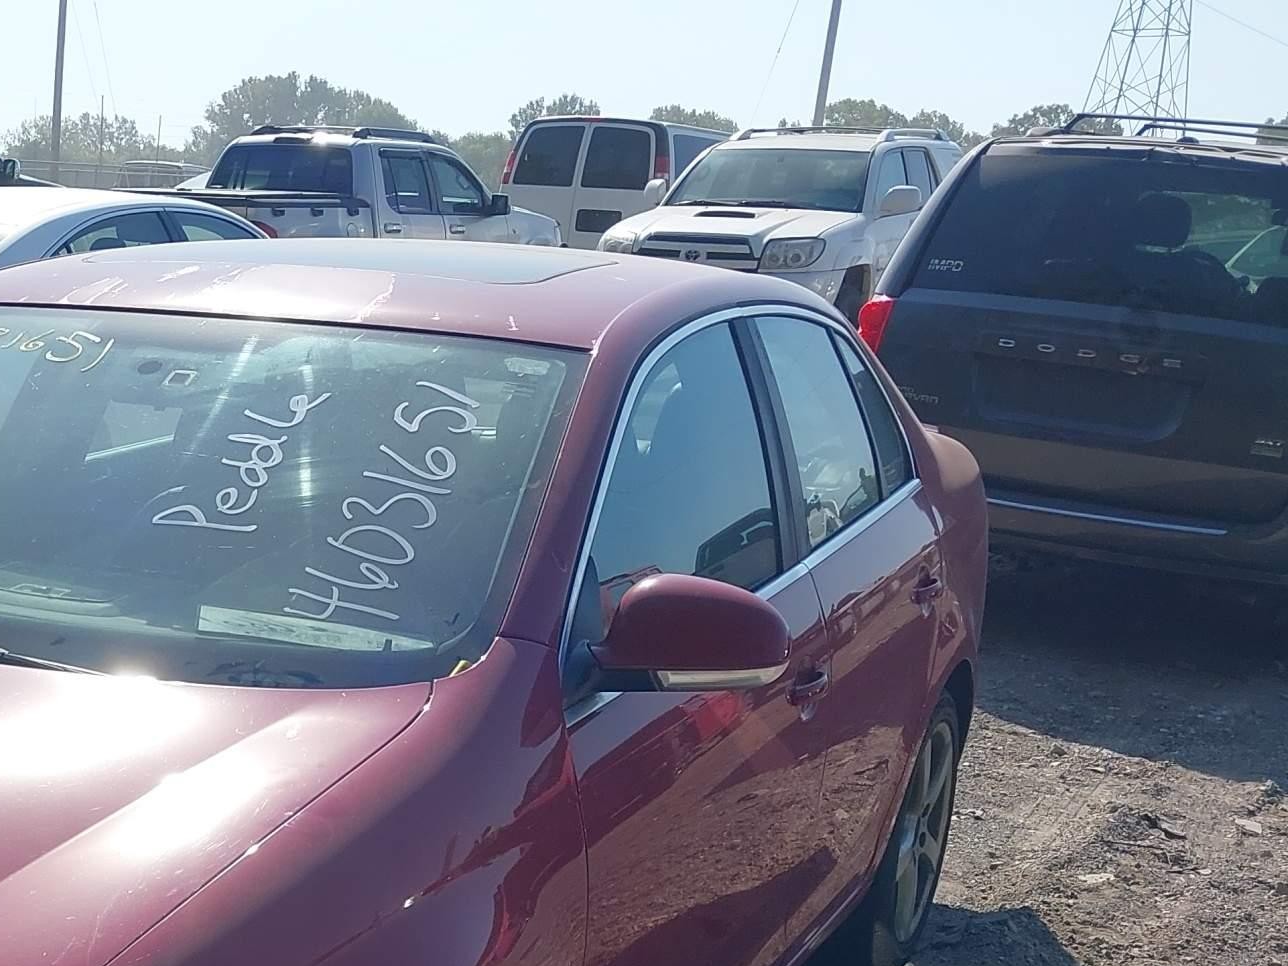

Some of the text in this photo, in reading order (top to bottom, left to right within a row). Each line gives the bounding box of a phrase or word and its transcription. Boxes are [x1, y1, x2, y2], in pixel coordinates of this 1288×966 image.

[928, 258, 964, 272] IMPD
[997, 337, 1183, 370] DODGE
[282, 380, 481, 621] 46031651
